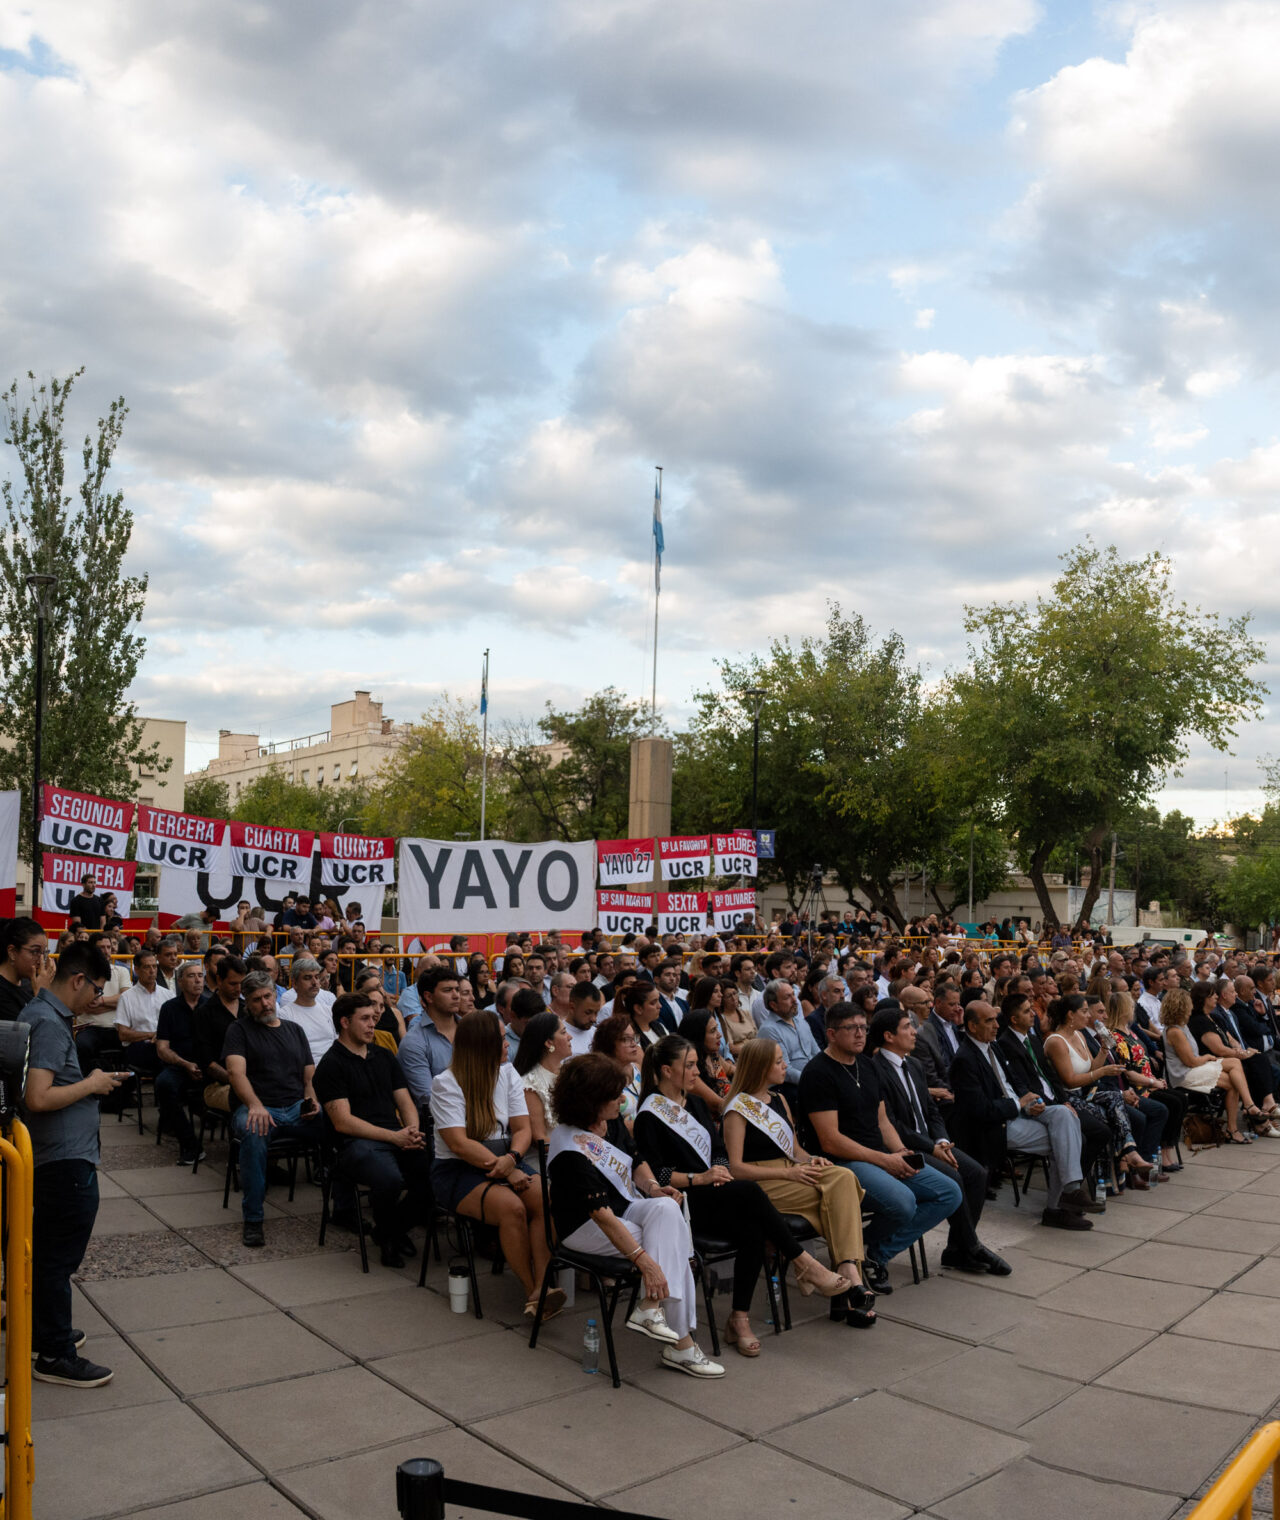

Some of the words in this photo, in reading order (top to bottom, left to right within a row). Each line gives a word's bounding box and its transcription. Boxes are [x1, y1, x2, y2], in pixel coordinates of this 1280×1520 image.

[50, 793, 123, 830] SEGUNDA
[147, 810, 215, 843] TERCERA
[52, 823, 114, 856] UCR
[244, 826, 300, 853] CUARTA
[333, 835, 385, 858] QUINTA
[670, 840, 679, 852] LA
[728, 837, 756, 854] FLORES
[148, 838, 207, 869] UCR
[602, 852, 633, 876] YAYO
[52, 858, 125, 889] PRIMERA
[242, 852, 298, 880] UCR
[333, 863, 385, 884] UCR
[669, 861, 704, 878] UCR
[722, 857, 752, 874] UCR
[407, 844, 579, 912] YAYO
[610, 892, 625, 906] SAN
[625, 894, 652, 908] MARTIN
[667, 893, 699, 912] SEXTA
[725, 891, 756, 907] OLIVARES
[606, 915, 644, 933] UCR
[666, 916, 701, 933] UCR
[721, 912, 745, 930] UC
